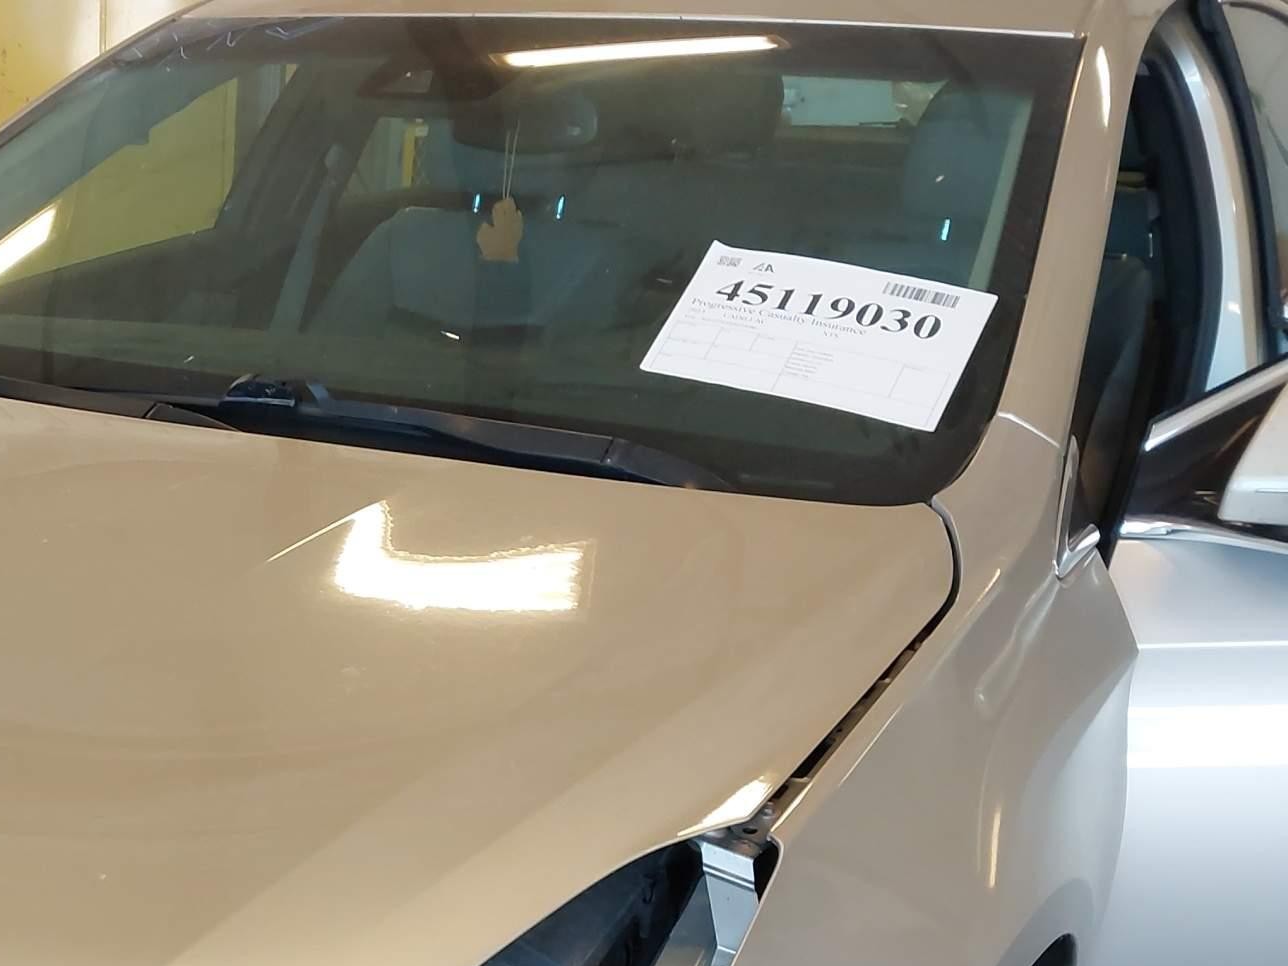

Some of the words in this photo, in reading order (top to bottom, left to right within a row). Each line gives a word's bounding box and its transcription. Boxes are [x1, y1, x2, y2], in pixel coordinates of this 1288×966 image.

[691, 298, 757, 314] Progressive
[759, 309, 805, 325] Casualty
[715, 279, 942, 340] 45119030
